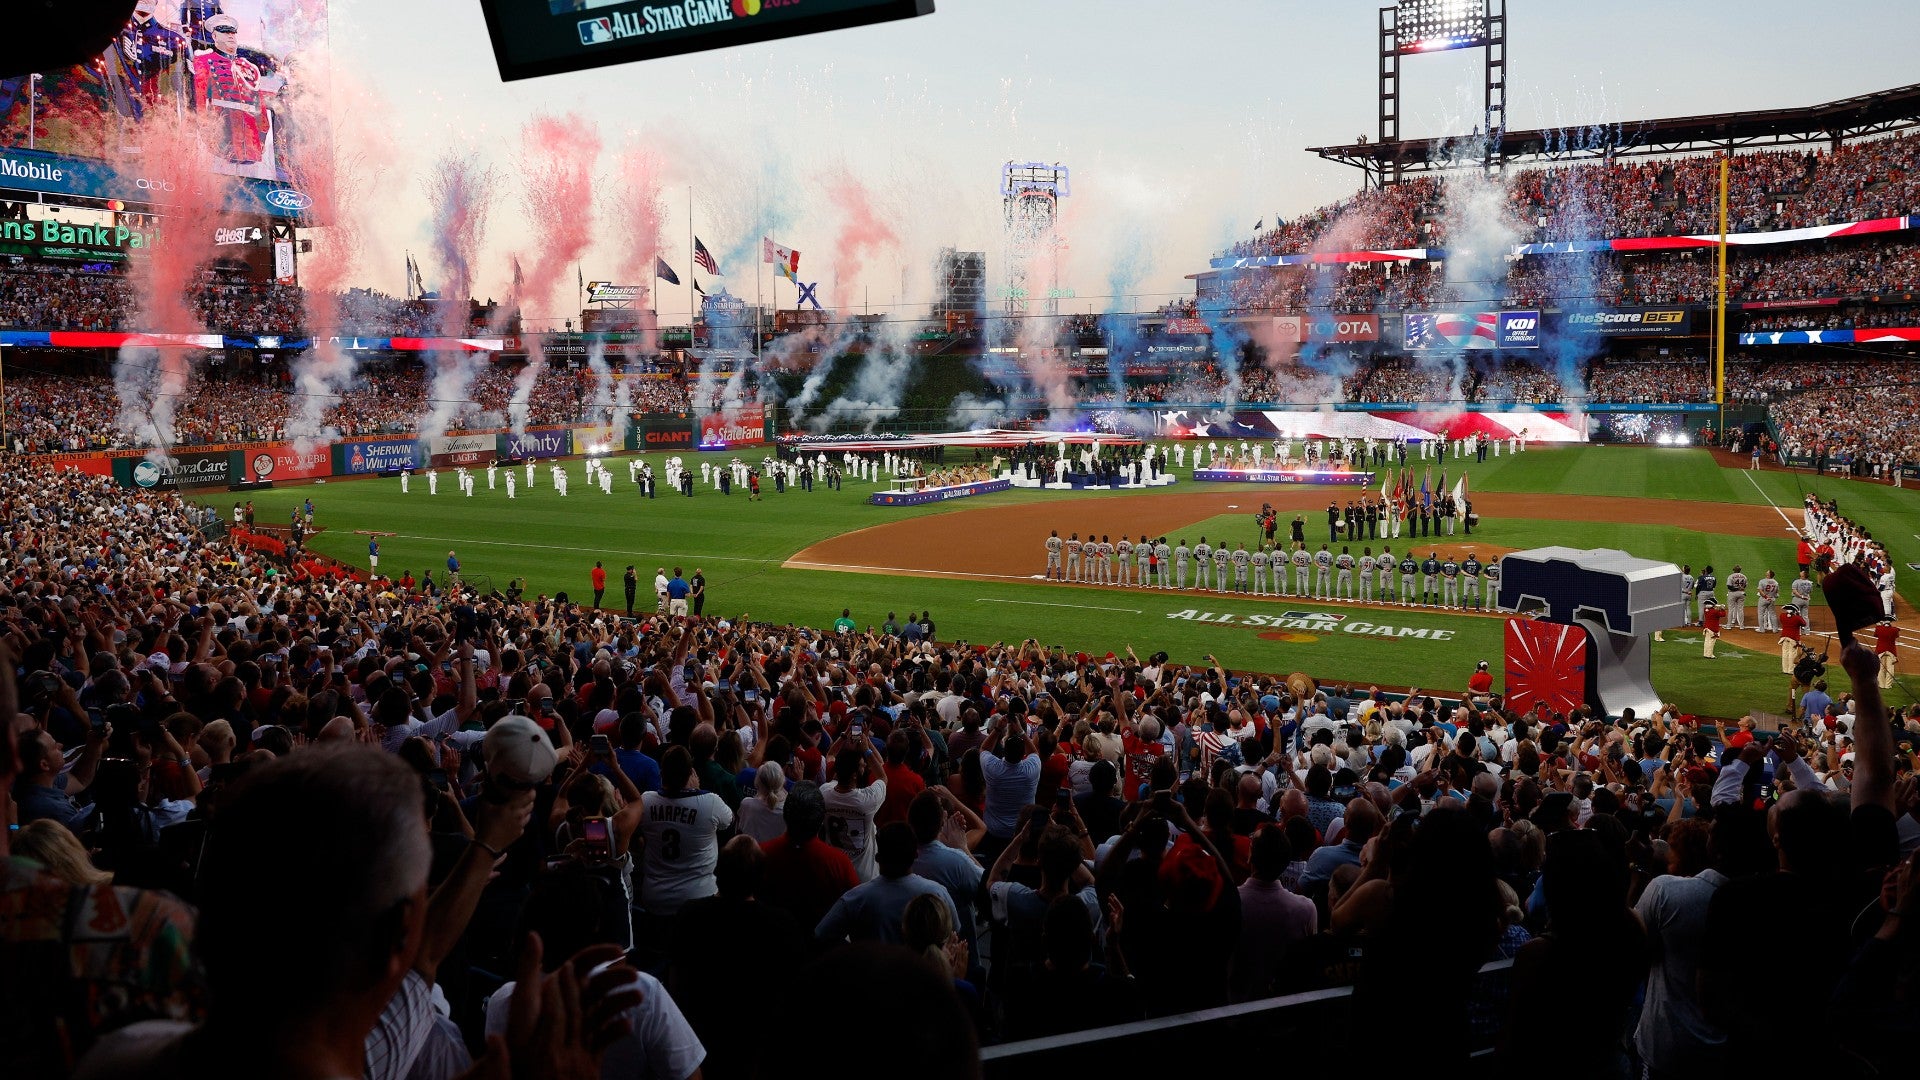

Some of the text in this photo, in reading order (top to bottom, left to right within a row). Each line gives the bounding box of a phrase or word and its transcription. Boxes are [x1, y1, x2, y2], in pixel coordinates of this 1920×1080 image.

[612, 12, 645, 38] ALL
[643, 4, 687, 33] STAR
[684, 0, 733, 27] GAME
[1, 158, 62, 182] Mobile
[276, 191, 303, 207] Ford
[42, 219, 110, 247] Bank
[1506, 319, 1536, 330] KDI
[1568, 312, 1681, 325] theScore BET
[1305, 322, 1373, 335] TOYOTA
[645, 431, 691, 443] GIANT
[223, 442, 268, 451] ASPLUNDH
[366, 444, 412, 457] SHERWIN
[444, 438, 484, 452] Yuengling
[511, 433, 561, 456] xfinity
[298, 453, 326, 464] WEBB
[451, 453, 478, 463] LAGER
[161, 459, 228, 476] NovaCare
[163, 473, 226, 486] REHABILITATION
[1735, 579, 1744, 587] 44
[1765, 584, 1776, 592] 27
[1167, 609, 1456, 641] ALL STAR GAME
[650, 805, 698, 825] HARPER
[661, 828, 681, 861] 3
